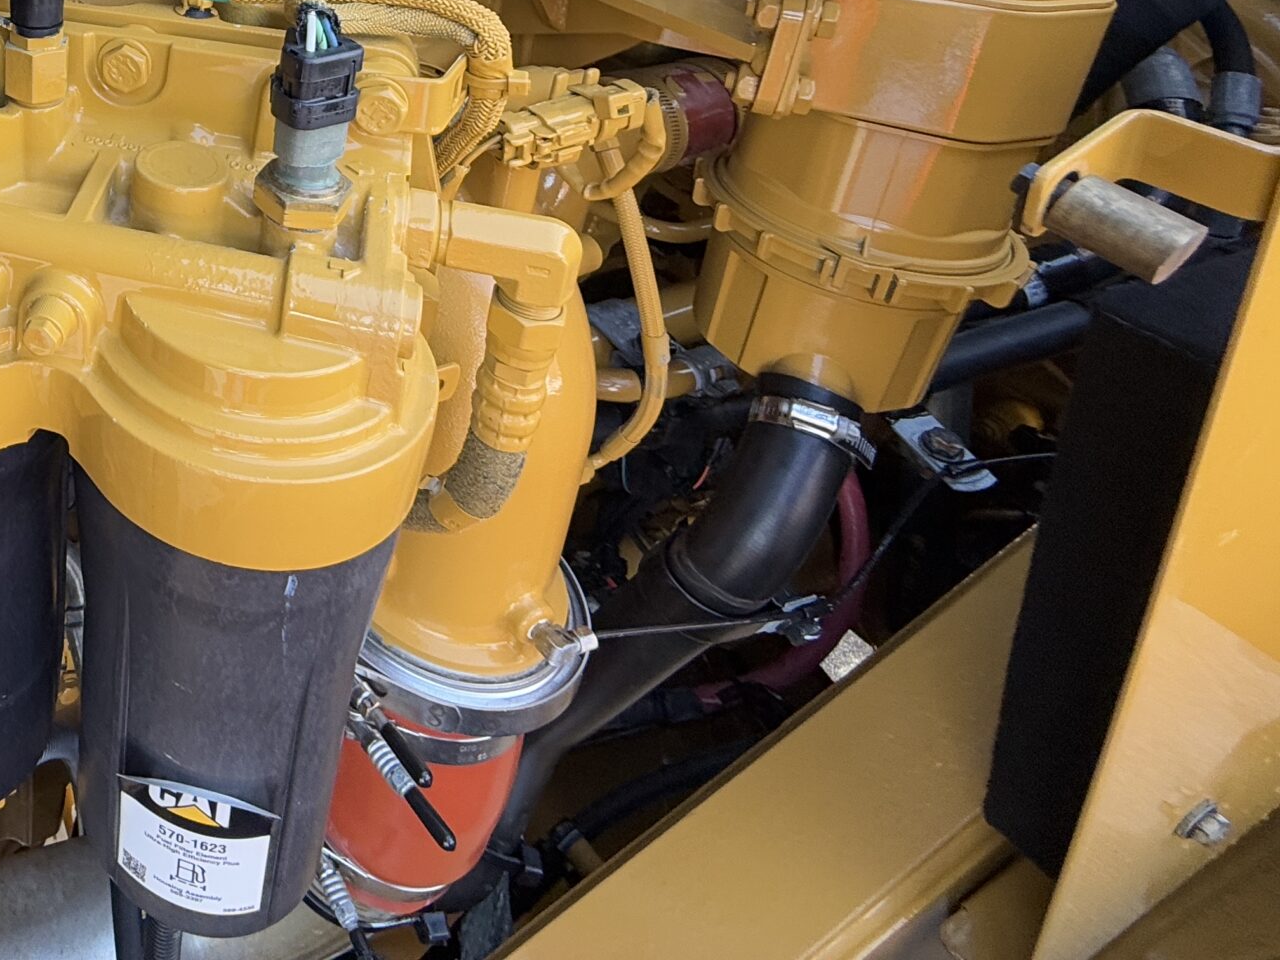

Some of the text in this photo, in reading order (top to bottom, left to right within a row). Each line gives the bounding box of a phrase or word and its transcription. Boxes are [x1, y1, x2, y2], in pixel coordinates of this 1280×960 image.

[158, 824, 227, 855] 570-1623
[182, 851, 220, 867] Efficiency
[195, 851, 228, 862] Element
[184, 890, 223, 902] Assembly
